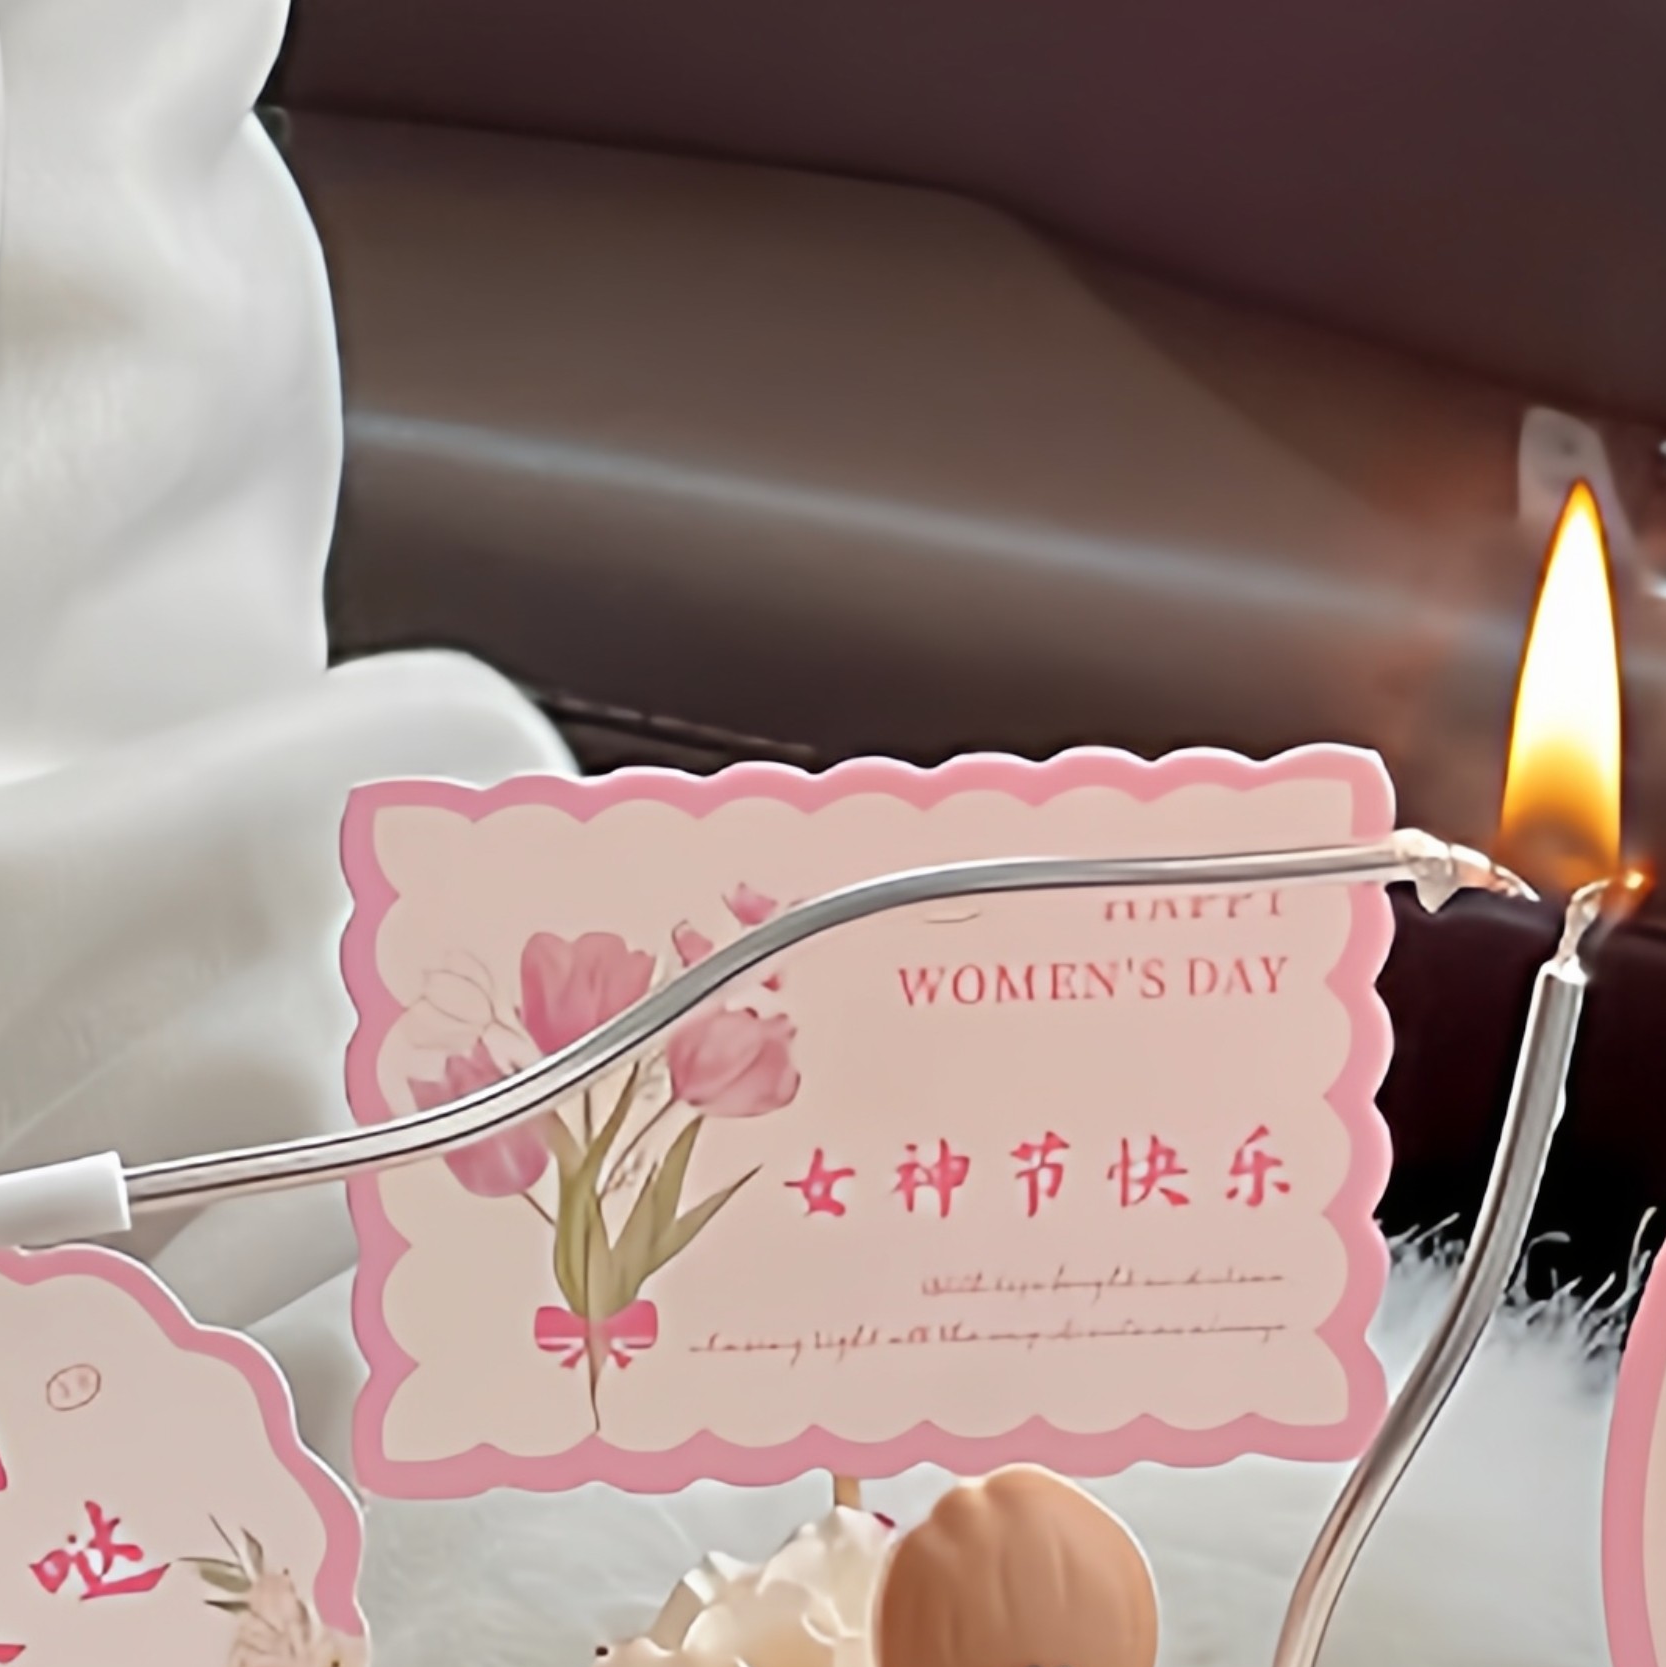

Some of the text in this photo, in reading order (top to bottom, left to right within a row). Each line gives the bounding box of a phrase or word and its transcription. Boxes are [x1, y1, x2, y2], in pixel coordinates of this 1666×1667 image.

[898, 955, 1290, 1006] WOMEN'S DAY
[784, 1124, 1292, 1218] 女神节快乐
